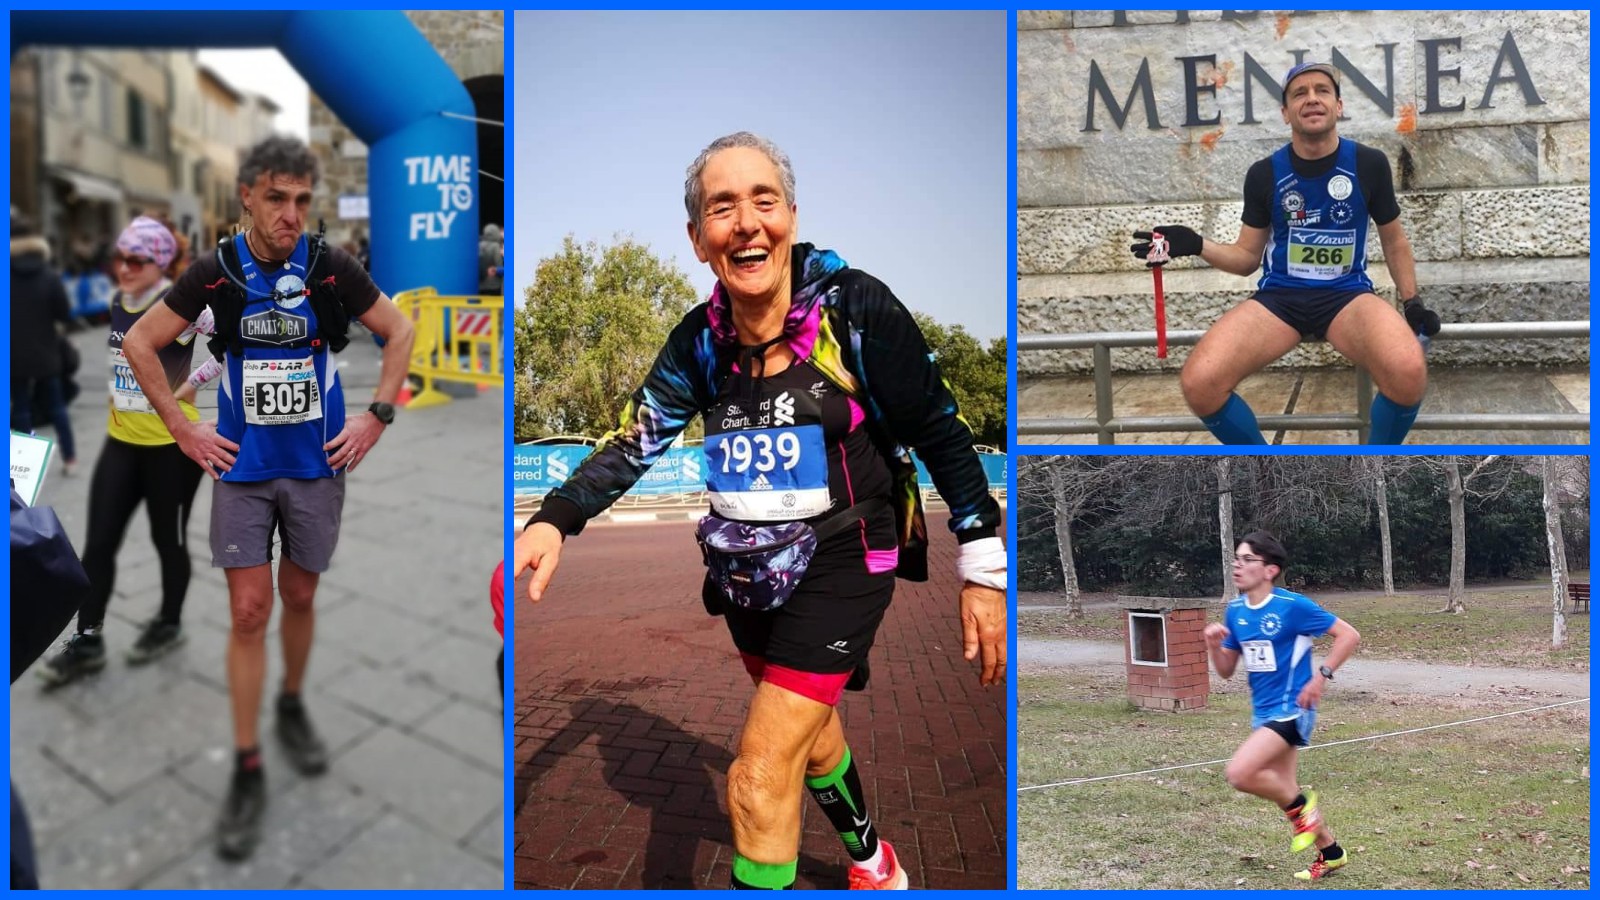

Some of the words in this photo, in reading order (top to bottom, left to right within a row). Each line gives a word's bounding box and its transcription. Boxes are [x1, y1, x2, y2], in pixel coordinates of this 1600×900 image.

[1081, 30, 1546, 131] MENNEA
[404, 155, 471, 185] TIME
[437, 183, 472, 210] TO
[410, 211, 457, 240] FLY
[1301, 247, 1343, 265] 266
[116, 366, 142, 390] 110
[260, 362, 302, 371] POLAR
[261, 382, 307, 414] 305
[719, 431, 801, 473] 1939
